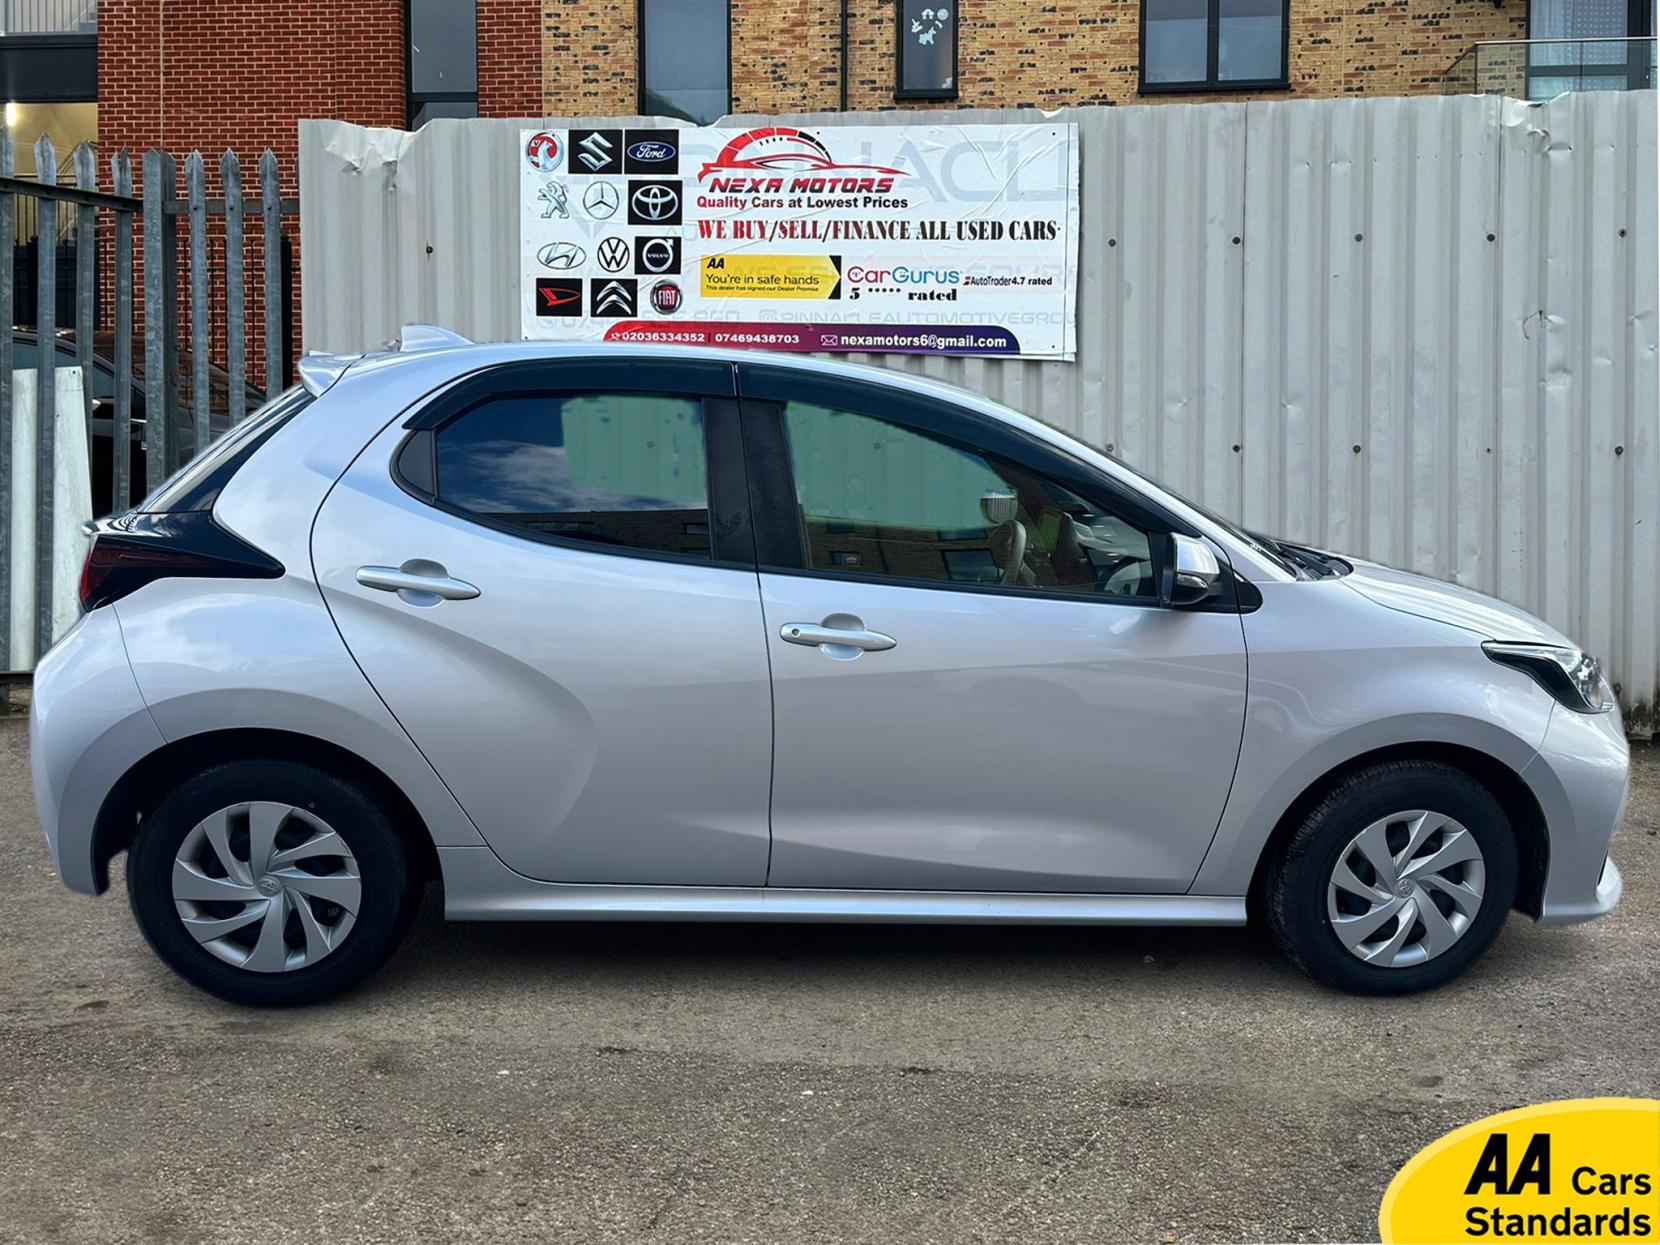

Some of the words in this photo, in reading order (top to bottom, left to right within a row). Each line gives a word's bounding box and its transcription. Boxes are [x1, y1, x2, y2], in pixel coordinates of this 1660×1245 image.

[636, 144, 665, 159] Ford
[709, 177, 784, 193] NEXA
[789, 177, 894, 194] MOTORS
[697, 195, 747, 210] Quality
[751, 195, 784, 208] Cars
[788, 196, 802, 208] at
[807, 196, 858, 208] Lowest
[863, 196, 908, 208] Prices
[697, 220, 727, 239] WE
[917, 220, 950, 240] ALL
[957, 220, 1004, 240] USED
[706, 257, 725, 269] AA
[706, 274, 741, 284] You're
[744, 274, 754, 284] in
[757, 274, 781, 285] safe
[784, 275, 819, 285] hands
[847, 266, 959, 284] CarGurus
[1028, 276, 1053, 286] rated
[658, 290, 676, 305] FIAT
[849, 287, 860, 301] 5
[908, 287, 957, 301] rated
[622, 333, 705, 342] 02036334352
[715, 333, 800, 343] 07469438703
[841, 334, 1007, 349] nexamotors6@gmail.com
